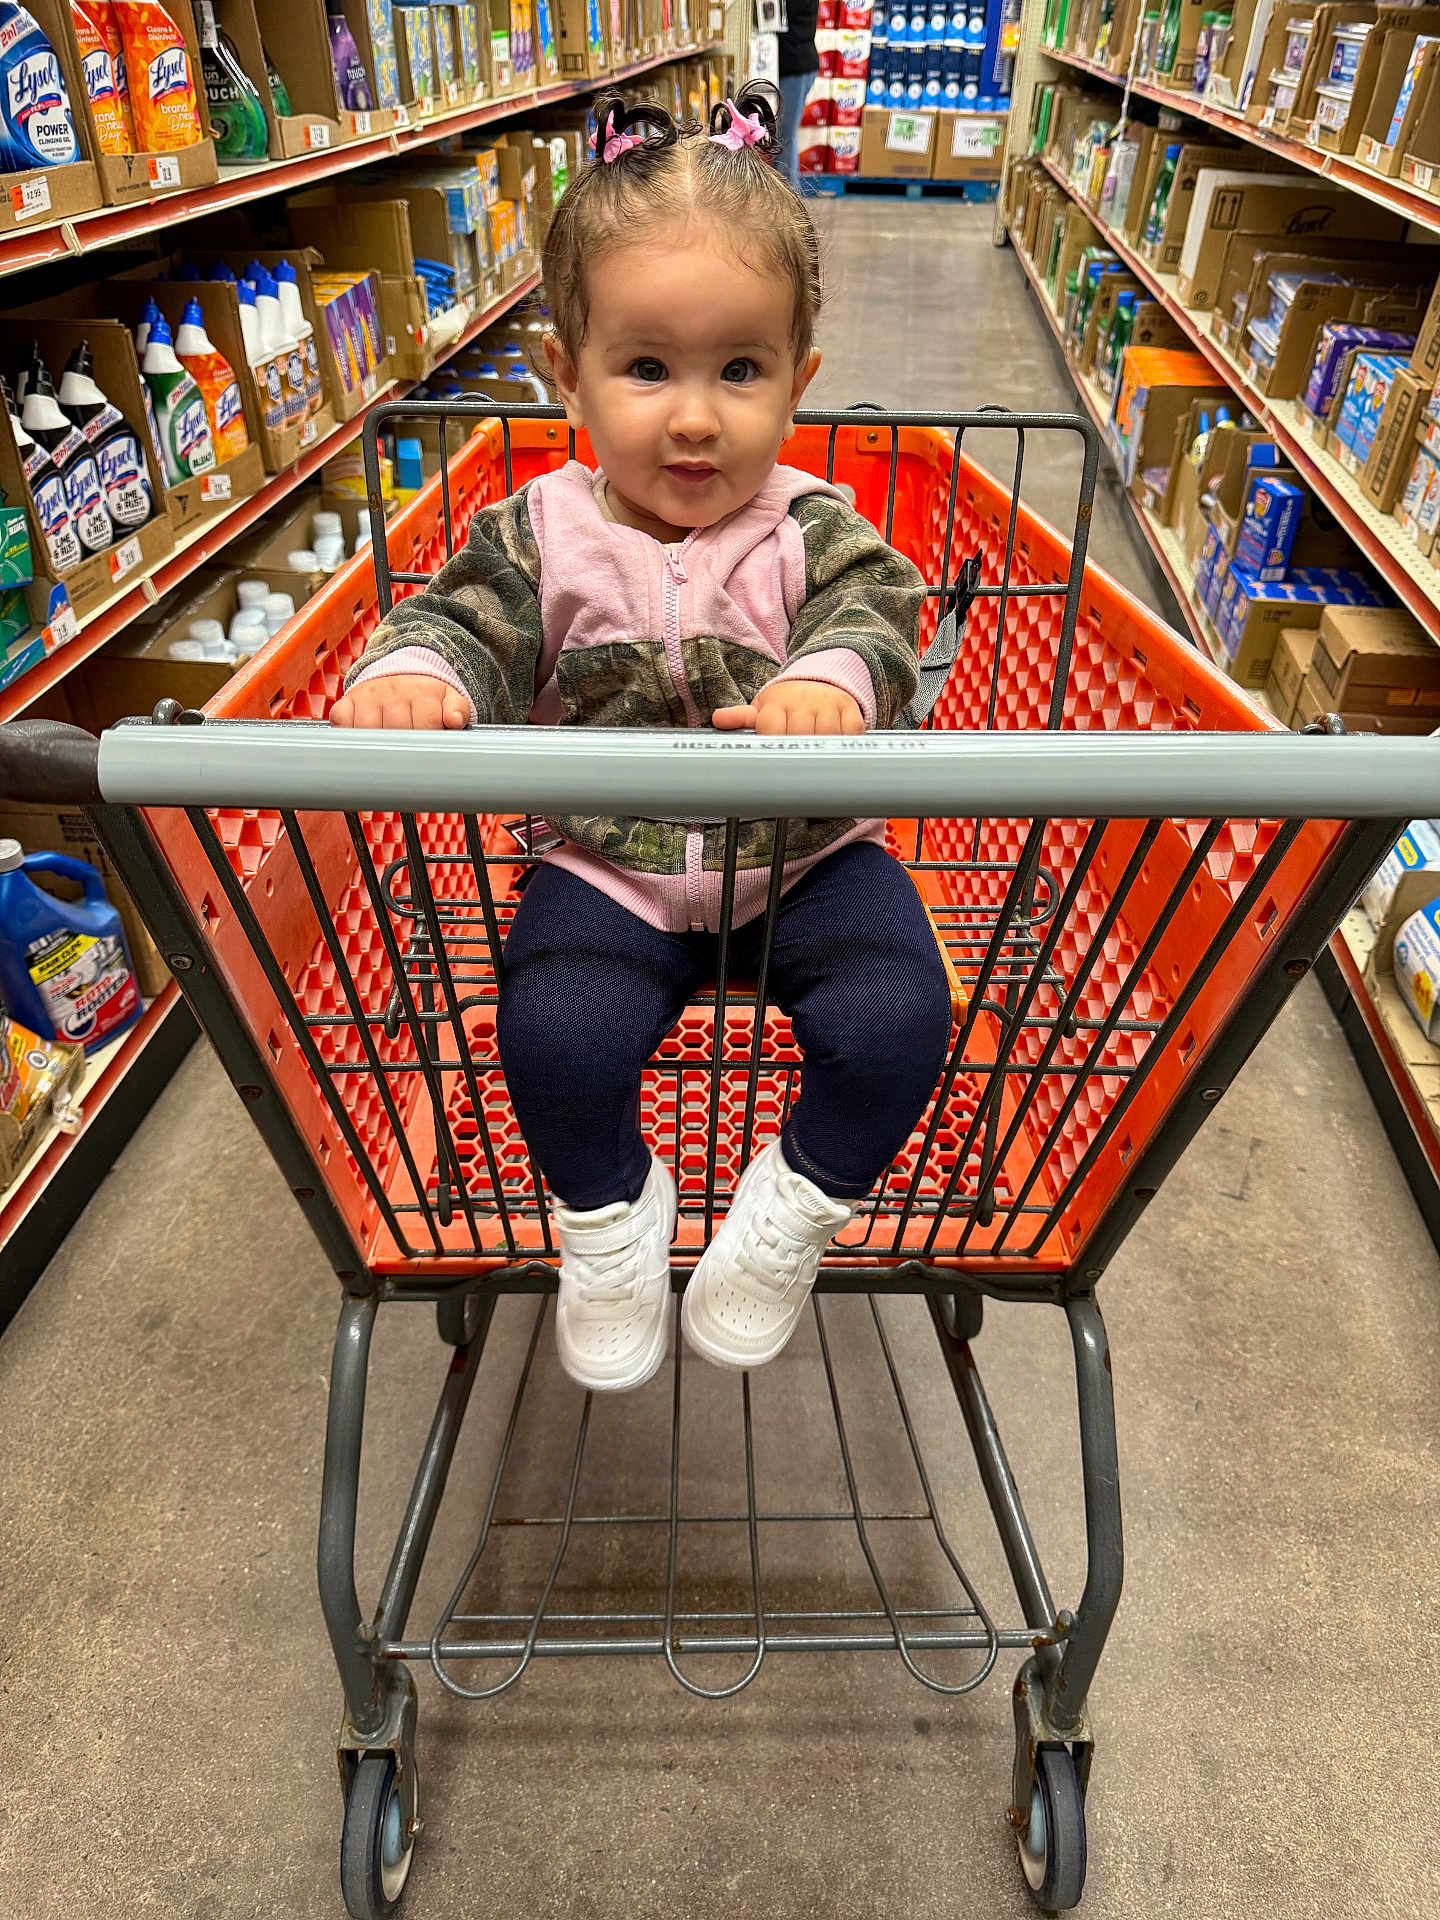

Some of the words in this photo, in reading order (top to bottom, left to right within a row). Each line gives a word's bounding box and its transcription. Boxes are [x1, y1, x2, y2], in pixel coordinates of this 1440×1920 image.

[10, 54, 56, 105] Lysol
[150, 51, 185, 88] Lysol
[160, 103, 188, 114] brand
[209, 86, 239, 100] UCH
[36, 123, 70, 137] POWER
[94, 111, 116, 121] rand
[95, 125, 122, 151] Day
[98, 438, 133, 483] Lysol
[66, 459, 97, 506] Lysol
[35, 477, 64, 526] Lysol
